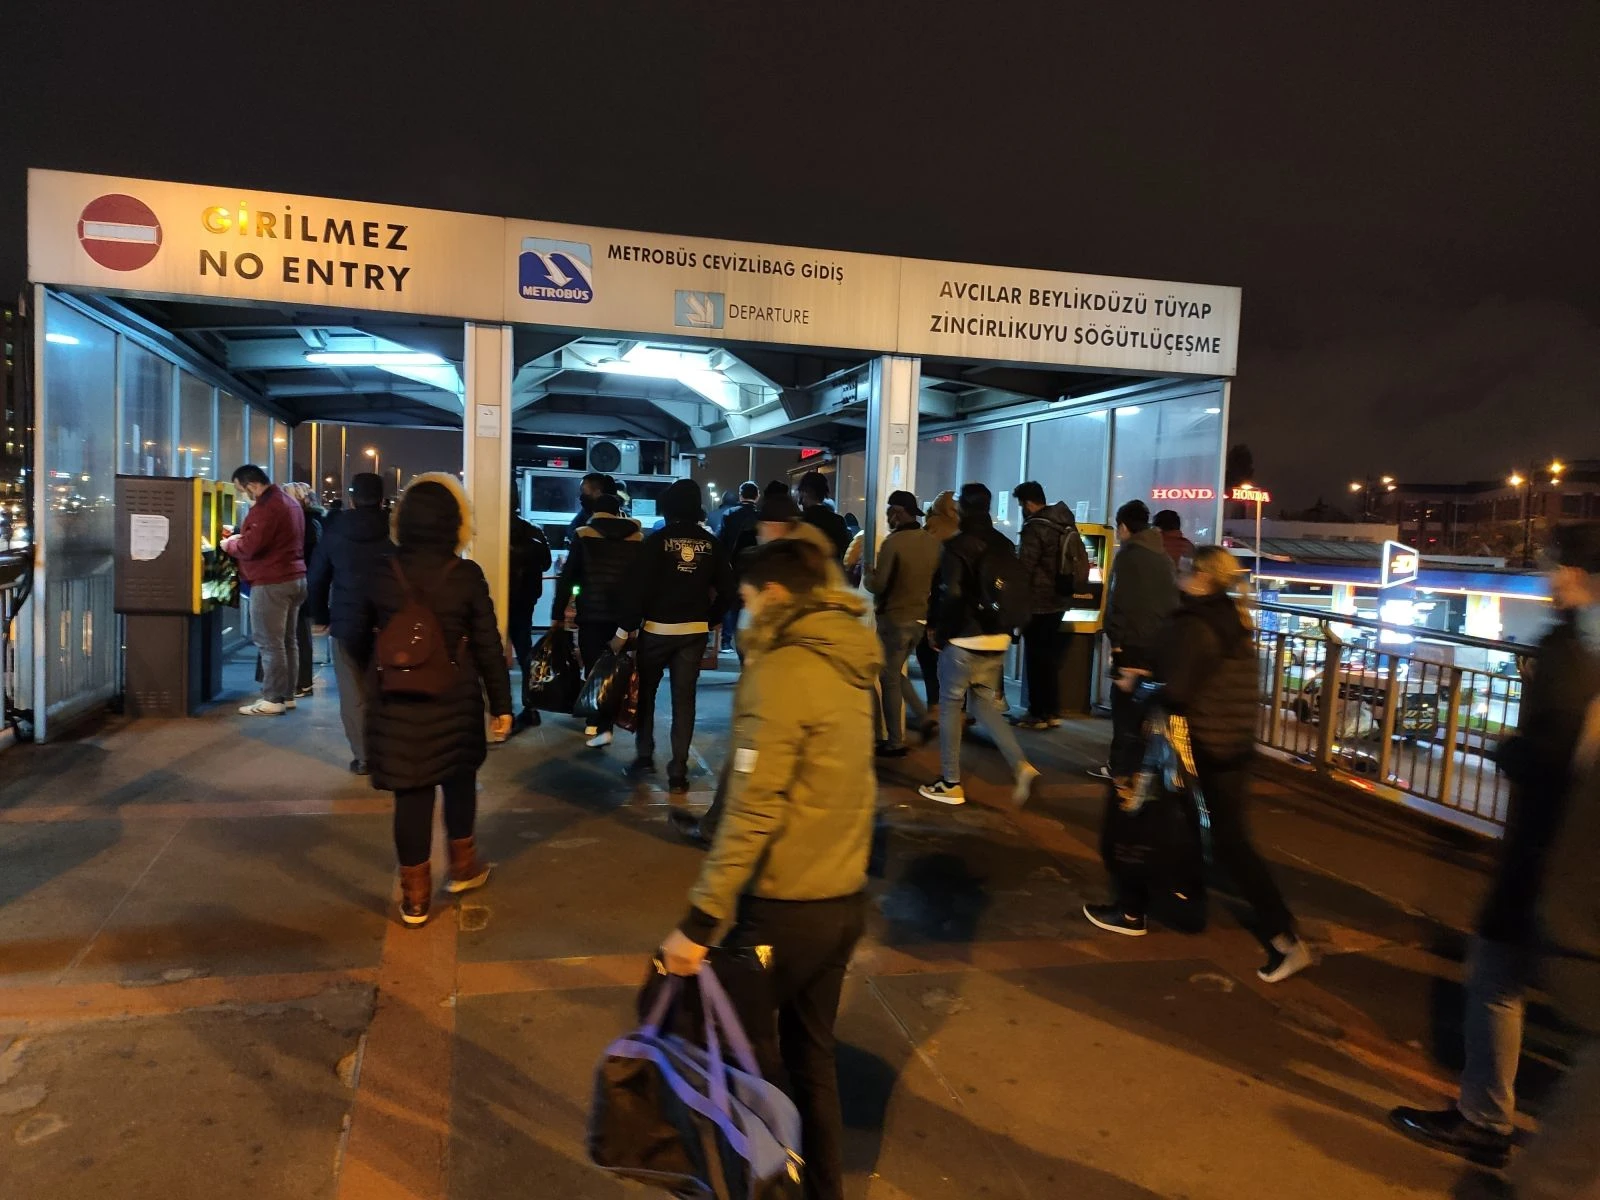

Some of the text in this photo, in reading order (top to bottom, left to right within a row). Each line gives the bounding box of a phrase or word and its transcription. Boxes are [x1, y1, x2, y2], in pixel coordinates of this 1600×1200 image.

[201, 201, 409, 251] GİRİLMEZ
[199, 249, 411, 292] NO ENTRY
[607, 243, 697, 268] METROBÜS
[801, 260, 844, 286] GİDİŞ
[522, 285, 590, 301] METROBÜS
[939, 280, 1212, 320] AVCILAR BEYLİKDÜZÜ TÜYAP
[728, 303, 809, 325] DEPARTURE
[929, 310, 1221, 357] ZİNCİRLİKUYU SÖĞÜTLÜÇEŞME
[1232, 488, 1270, 502] HONDA
